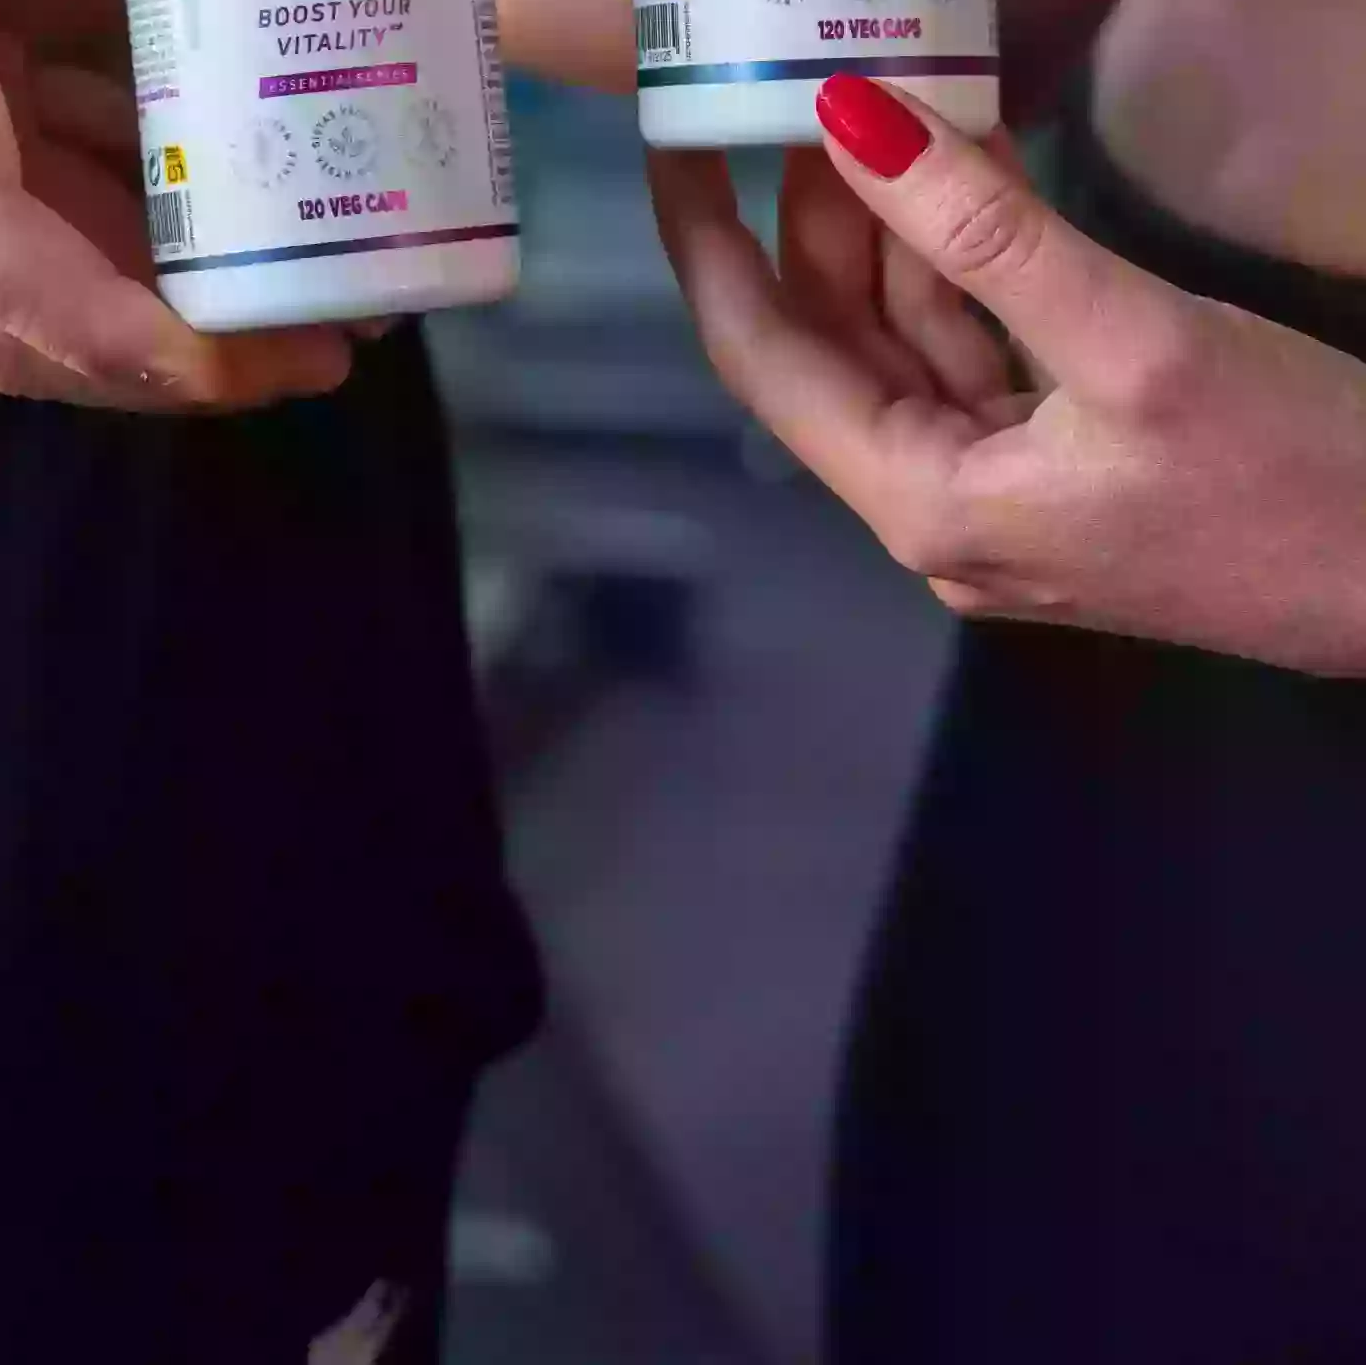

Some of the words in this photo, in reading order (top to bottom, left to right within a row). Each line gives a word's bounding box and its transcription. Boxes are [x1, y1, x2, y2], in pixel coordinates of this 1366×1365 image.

[258, 1, 342, 29] BOOST
[817, 20, 845, 40] 120
[848, 18, 881, 39] VEG
[883, 17, 922, 39] CAPS
[297, 198, 325, 220] 120
[329, 194, 362, 217] VEG
[366, 190, 408, 213] CA
